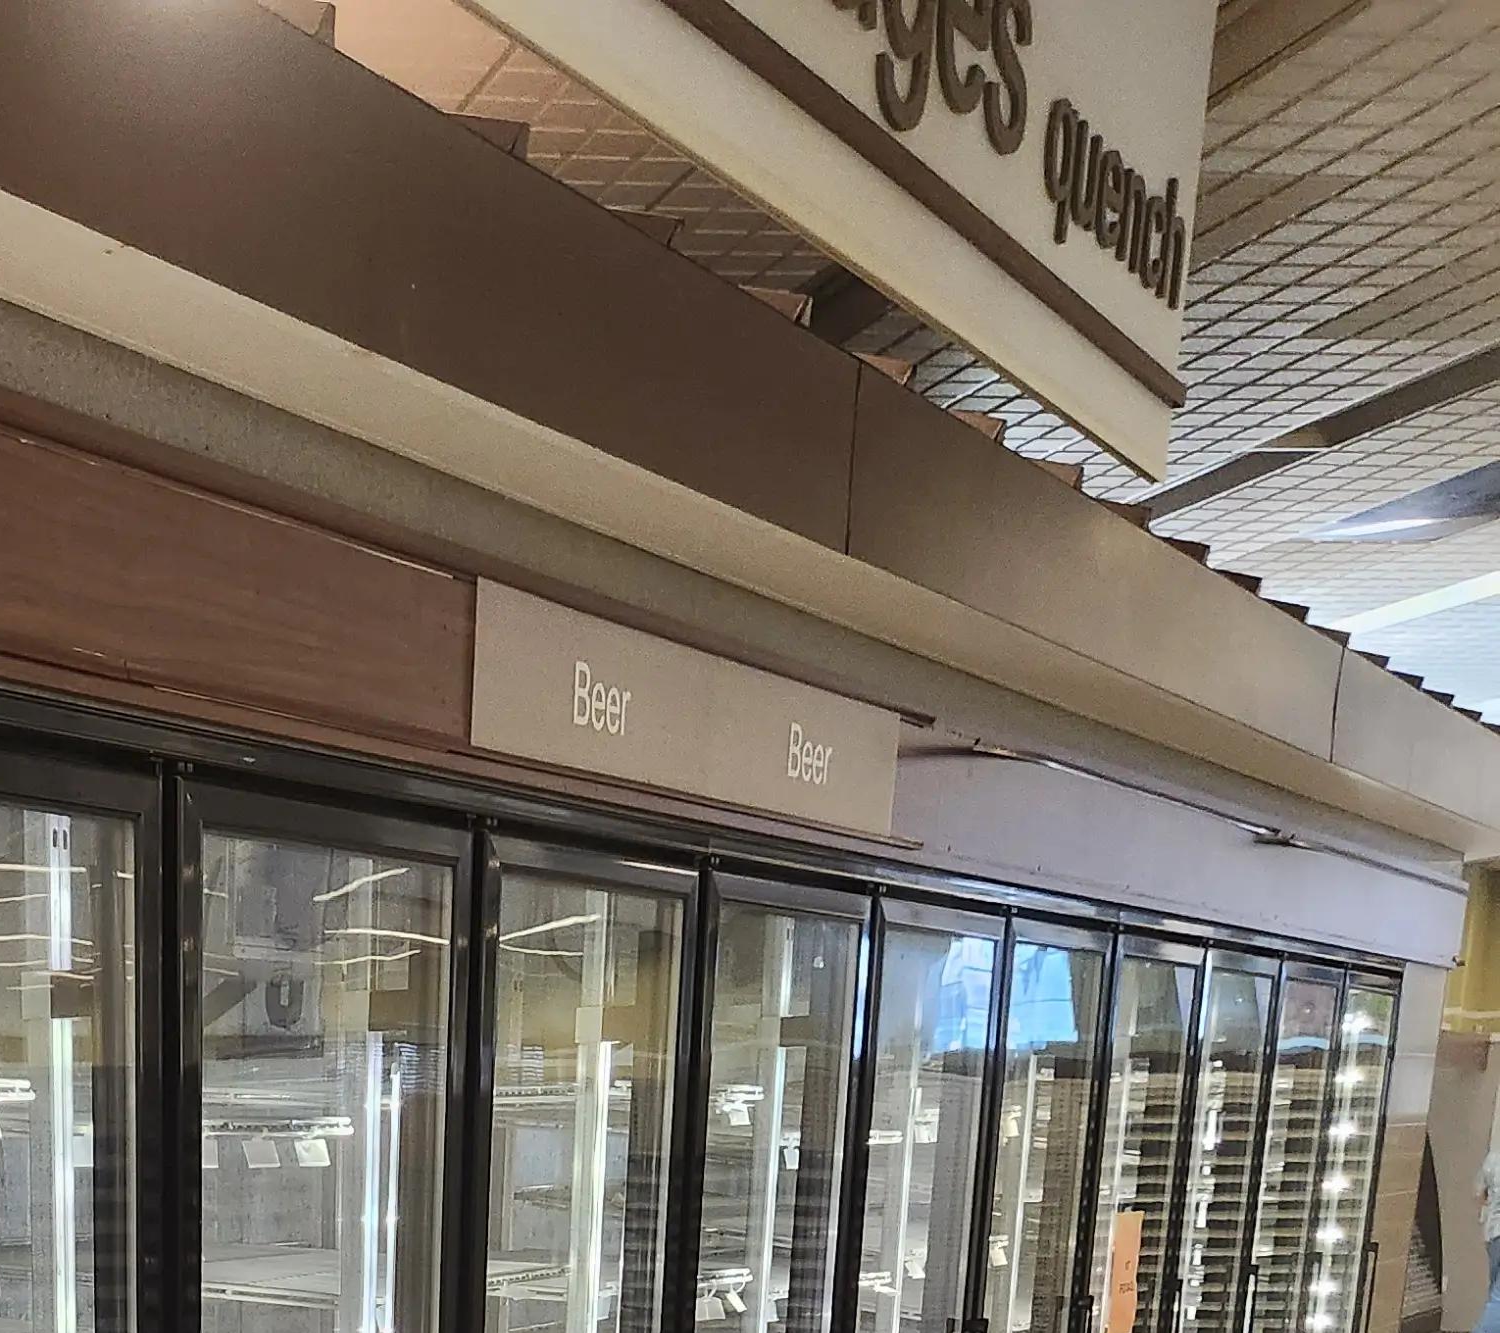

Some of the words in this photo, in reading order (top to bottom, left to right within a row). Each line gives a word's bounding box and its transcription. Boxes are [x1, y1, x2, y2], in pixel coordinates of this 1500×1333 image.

[832, 0, 1033, 156] ges
[1043, 98, 1186, 310] quench
[572, 660, 632, 736] Beer
[786, 721, 833, 785] Beer
